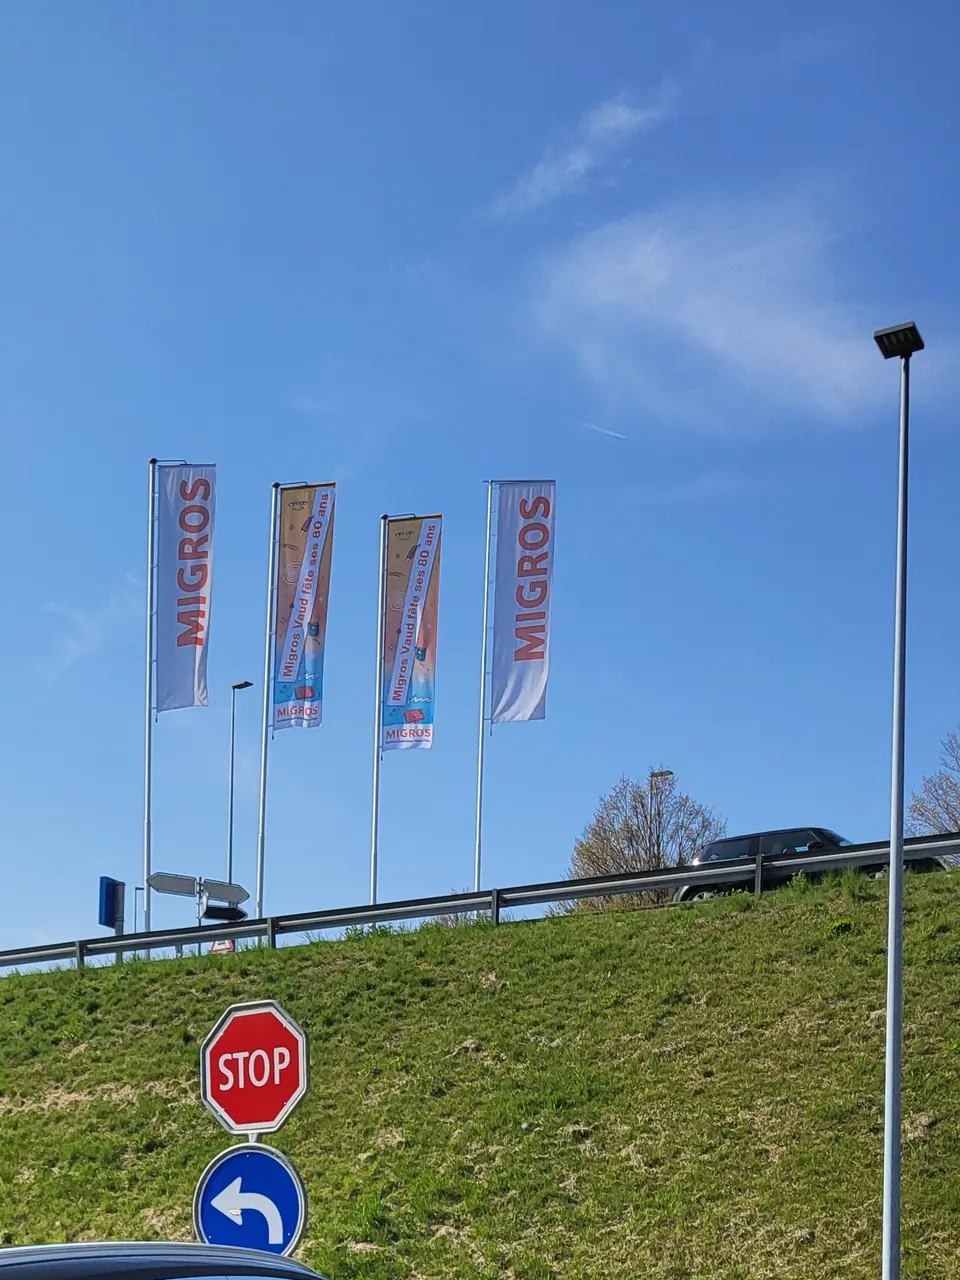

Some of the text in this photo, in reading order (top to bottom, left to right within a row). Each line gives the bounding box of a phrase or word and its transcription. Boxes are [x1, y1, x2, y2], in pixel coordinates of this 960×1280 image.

[177, 477, 211, 647] MIGROS
[282, 493, 329, 678] Migros Vaud fête ses 80 ans
[392, 524, 436, 701] Migros Vaud fête ses 80 ans
[514, 496, 551, 662] MIGROS
[276, 705, 318, 718] MIGROS
[385, 728, 431, 739] MIGROS
[218, 1046, 291, 1091] STOP
